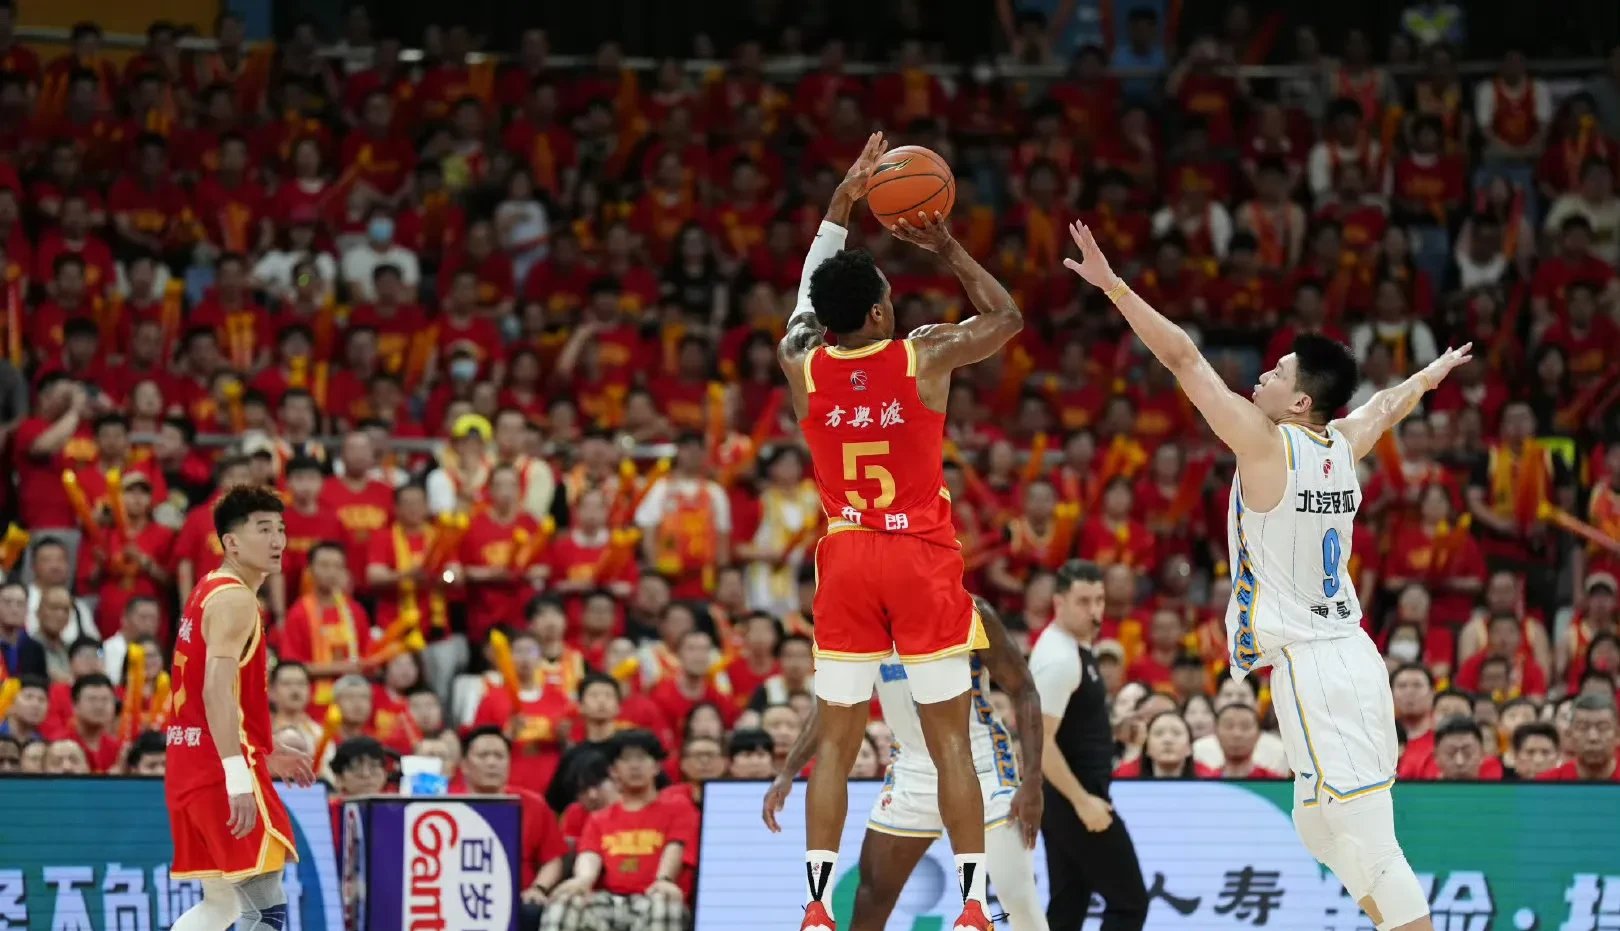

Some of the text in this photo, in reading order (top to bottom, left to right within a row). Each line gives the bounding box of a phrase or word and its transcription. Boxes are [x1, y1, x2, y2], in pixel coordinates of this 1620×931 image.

[842, 440, 896, 509] 5
[1322, 528, 1341, 598] 9
[460, 838, 493, 931] 百岁
